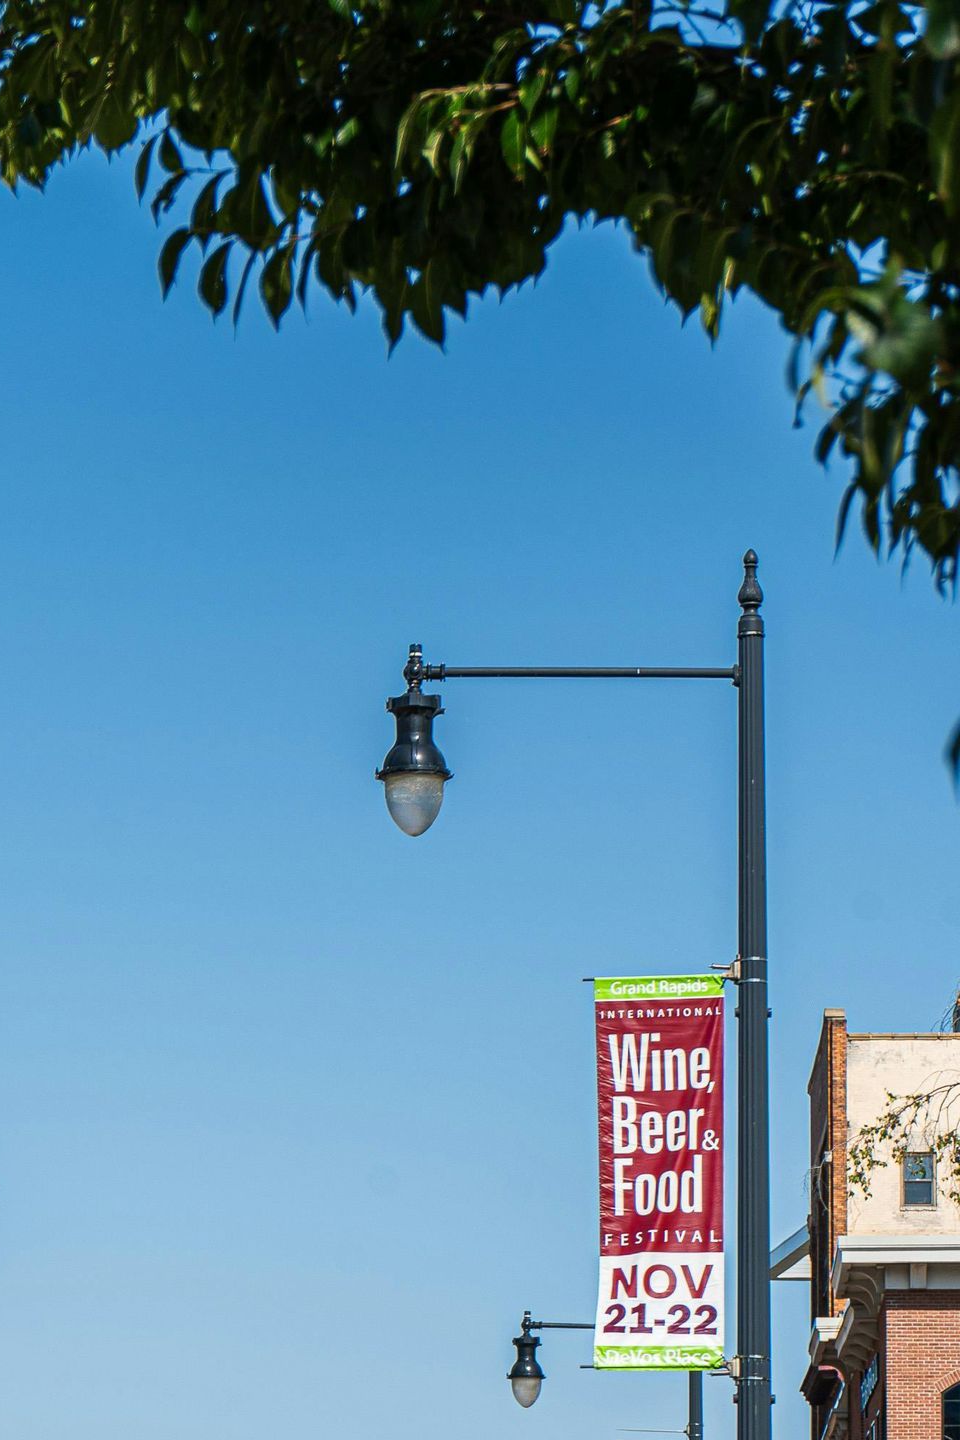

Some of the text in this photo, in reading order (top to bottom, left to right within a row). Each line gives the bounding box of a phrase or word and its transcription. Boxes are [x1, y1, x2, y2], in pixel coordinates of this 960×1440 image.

[610, 978, 709, 996] Grand Rapids
[599, 1006, 722, 1019] INTERNATIONAL
[608, 1032, 715, 1094] Wine,
[613, 1154, 703, 1217] Food
[604, 1229, 722, 1247] FESTIVAL
[609, 1264, 714, 1300] NOV
[602, 1303, 718, 1337] 21-22
[605, 1348, 711, 1364] DeVos Place
